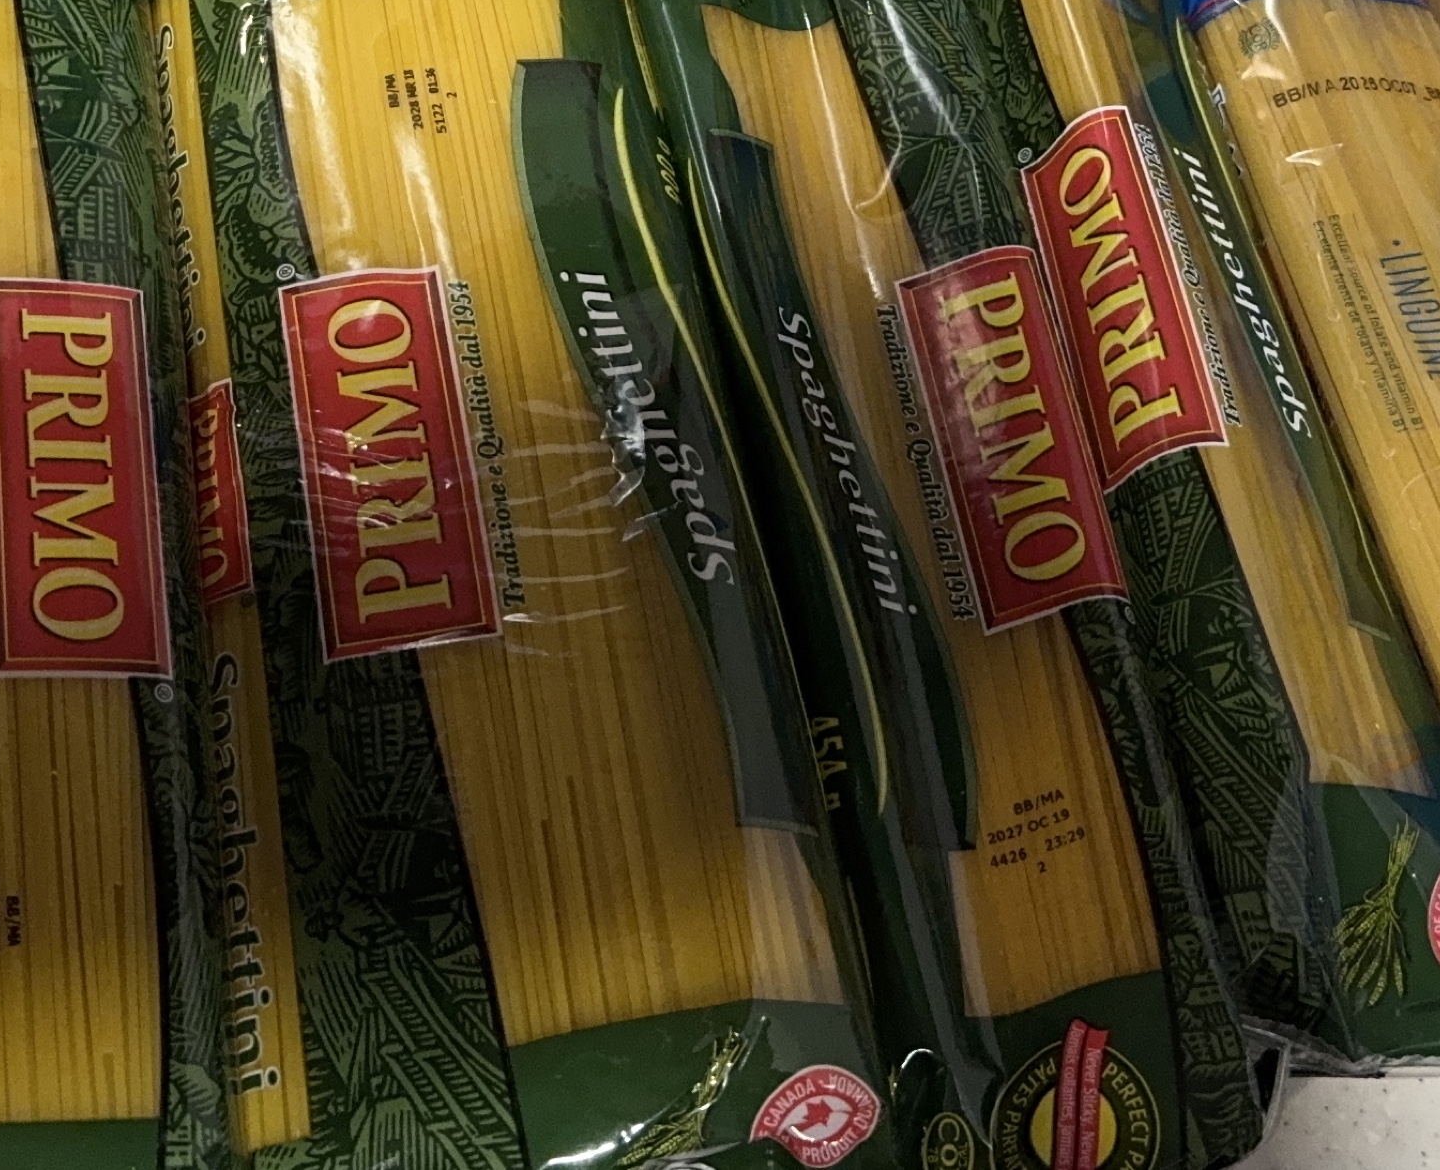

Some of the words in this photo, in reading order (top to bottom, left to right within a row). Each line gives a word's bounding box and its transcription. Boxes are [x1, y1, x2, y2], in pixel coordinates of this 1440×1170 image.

[451, 280, 477, 333] 1954
[1060, 148, 1186, 451] PRIMO
[1172, 147, 1312, 439] Spaghettini
[472, 374, 505, 459] Qualità
[939, 271, 1086, 581] PRIMO
[1392, 370, 1416, 414] vitamin
[20, 308, 125, 641] PRIMO
[328, 299, 455, 625] PRIMO
[776, 307, 919, 618] Spaghettini
[875, 303, 918, 418] Tradizione
[906, 437, 951, 523] Qualità
[943, 568, 977, 622] 1954
[490, 481, 527, 608] Tradizione
[987, 823, 1023, 845] 2027
[1028, 815, 1049, 832] OC
[1052, 808, 1070, 824] 19
[1013, 789, 1065, 816] BB/MA
[990, 847, 1027, 868] 4426
[1045, 826, 1085, 851] 23:29
[763, 1077, 816, 1128] CANADA
[1083, 1047, 1102, 1085] Never
[1101, 1061, 1150, 1147] PERFECT
